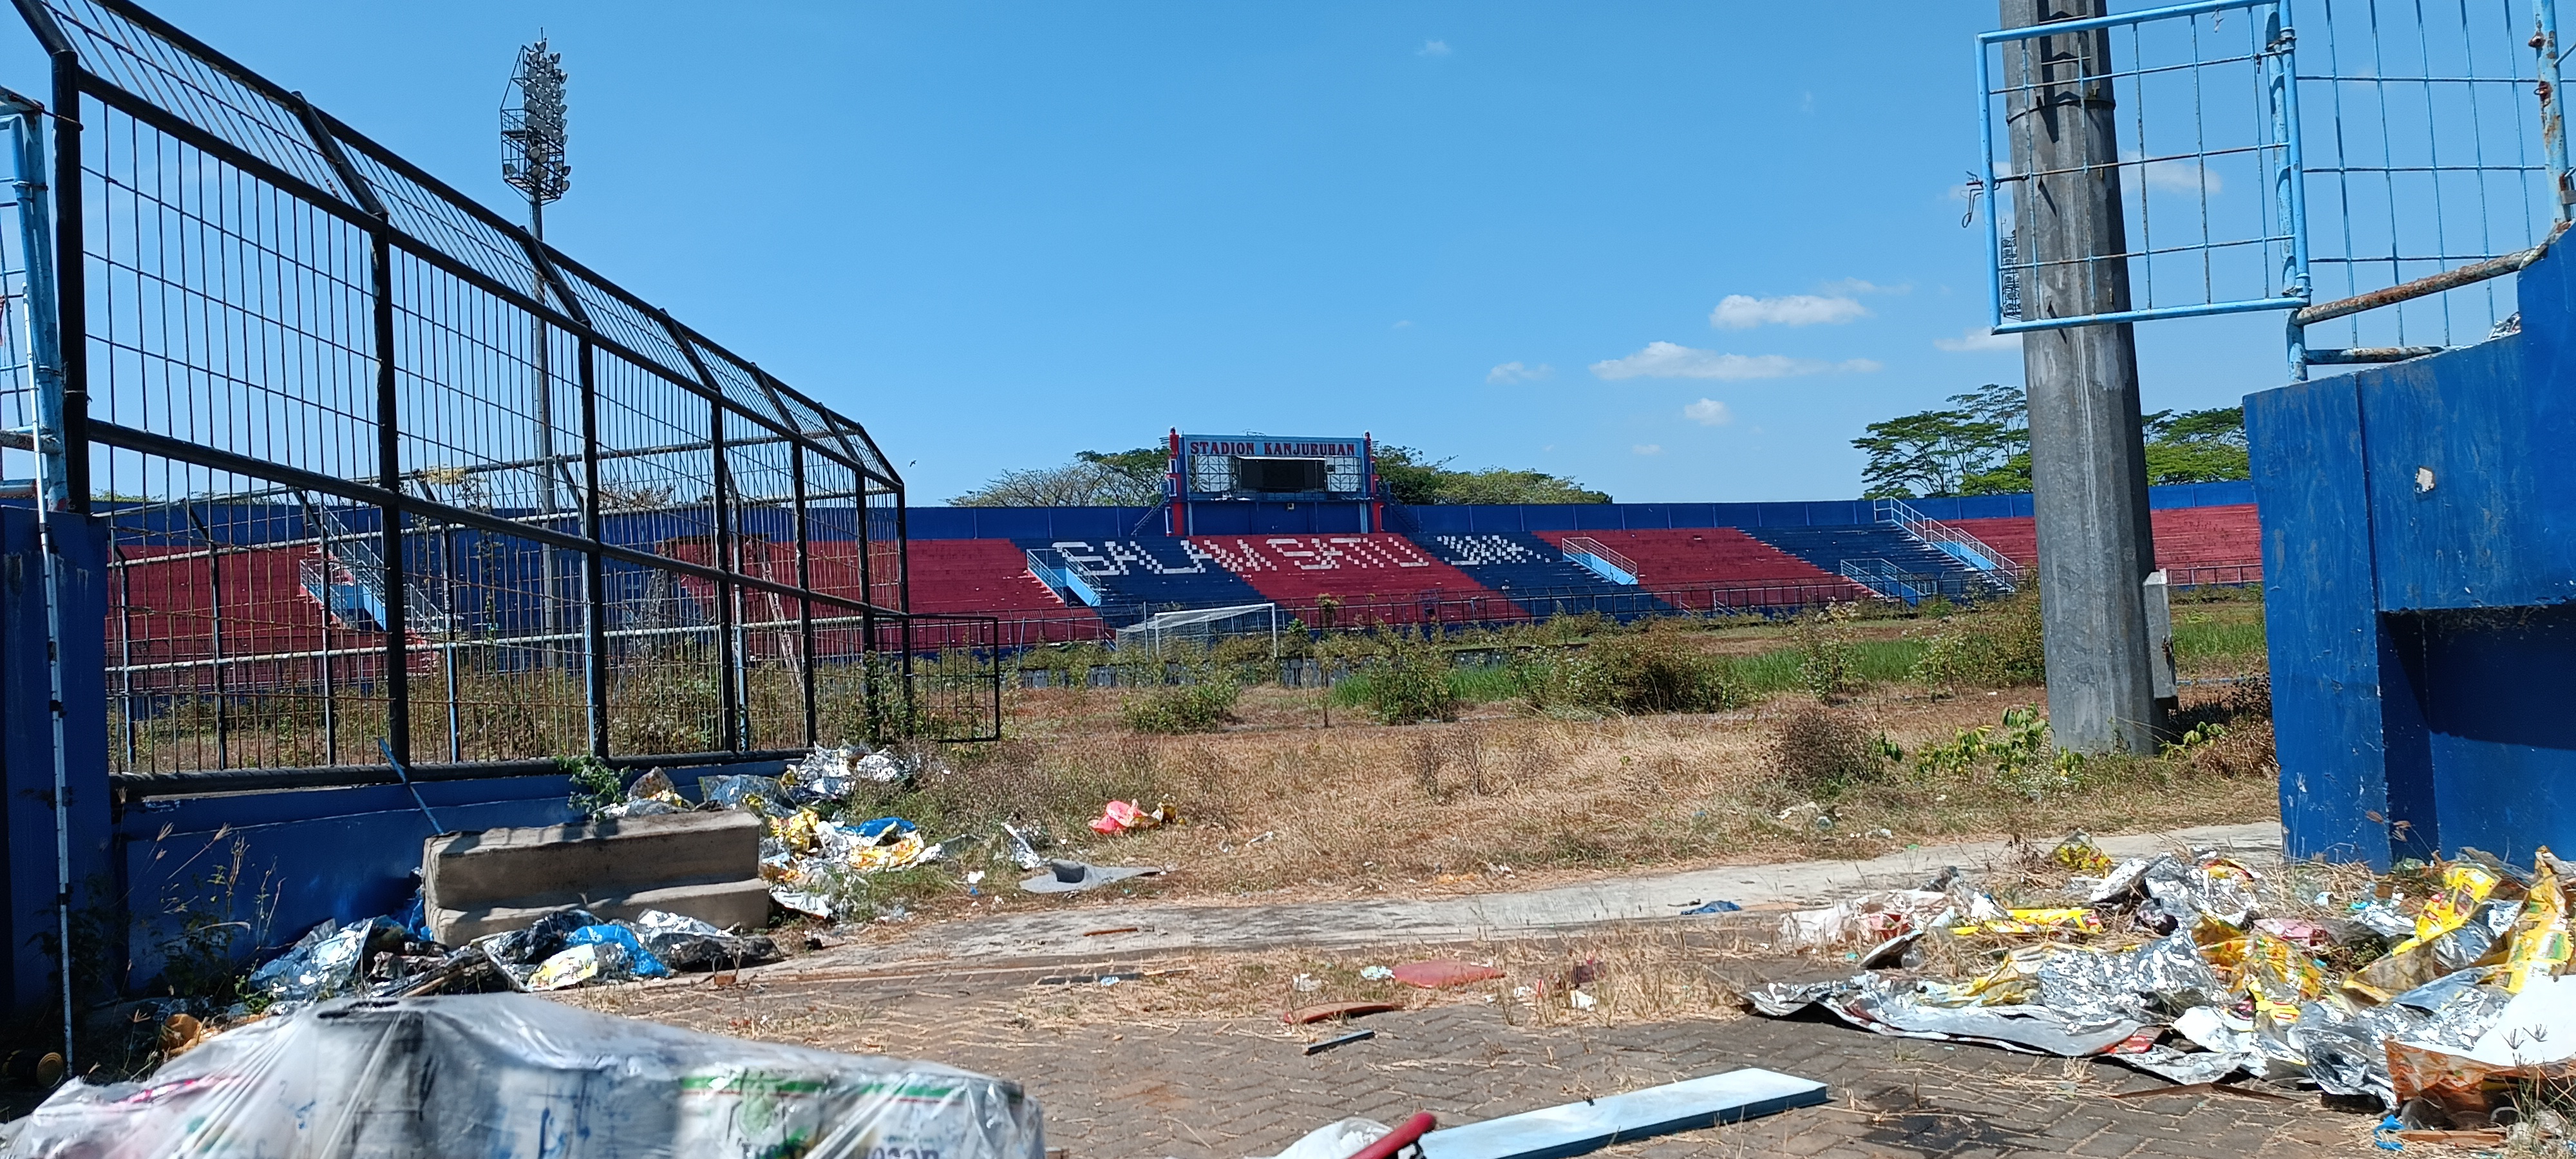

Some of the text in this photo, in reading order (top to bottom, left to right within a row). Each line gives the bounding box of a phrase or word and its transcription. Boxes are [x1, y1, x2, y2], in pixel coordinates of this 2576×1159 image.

[1190, 442, 1354, 456] STADION KANJURUHAN
[1266, 538, 1430, 570] SATU
